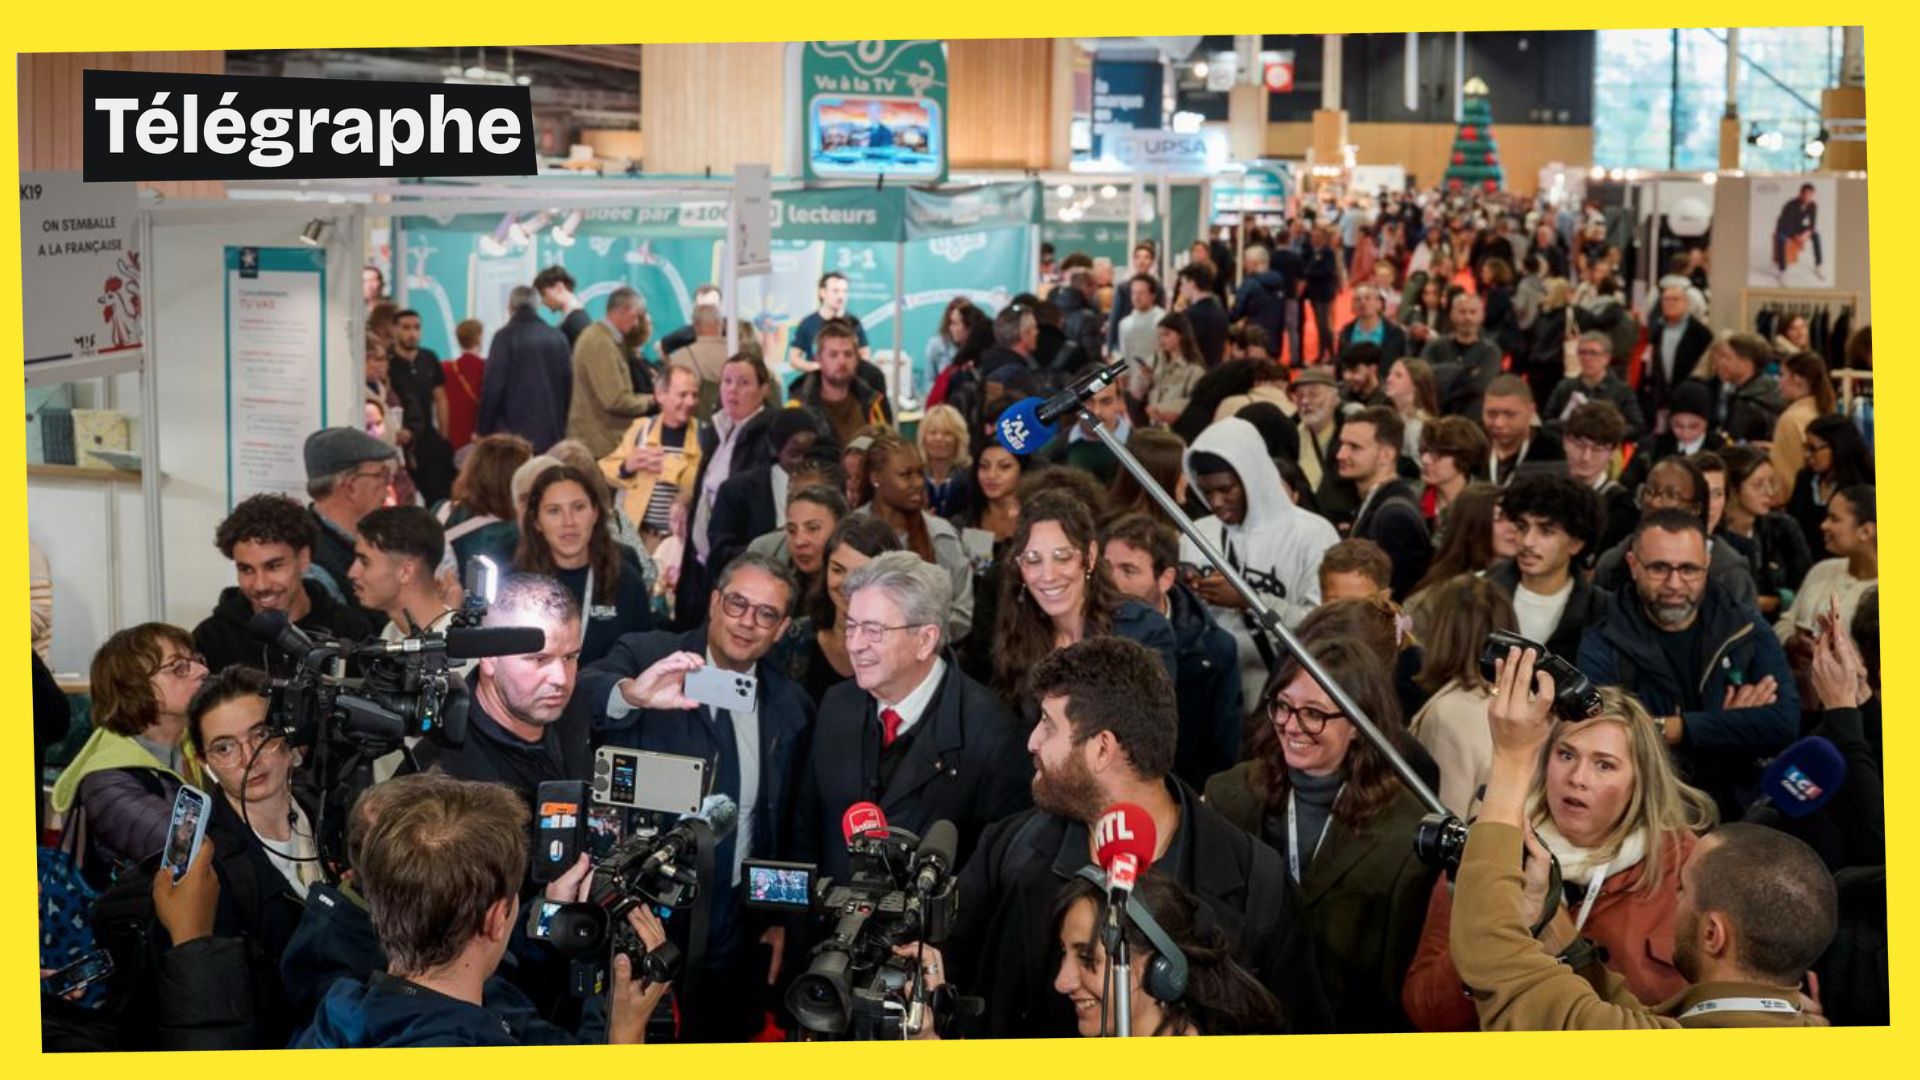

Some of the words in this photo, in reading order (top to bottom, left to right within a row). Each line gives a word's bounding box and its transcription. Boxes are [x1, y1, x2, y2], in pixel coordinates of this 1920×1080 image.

[873, 78, 896, 92] TV
[1145, 139, 1207, 154] UPSA
[20, 184, 42, 200] K19
[788, 205, 877, 225] lecteurs
[42, 219, 59, 232] ON
[62, 216, 116, 231] S'EMBALLE
[38, 245, 46, 257] A
[48, 243, 62, 256] LA
[65, 239, 122, 256] FRANÇAISE
[1096, 811, 1135, 850] RTL
